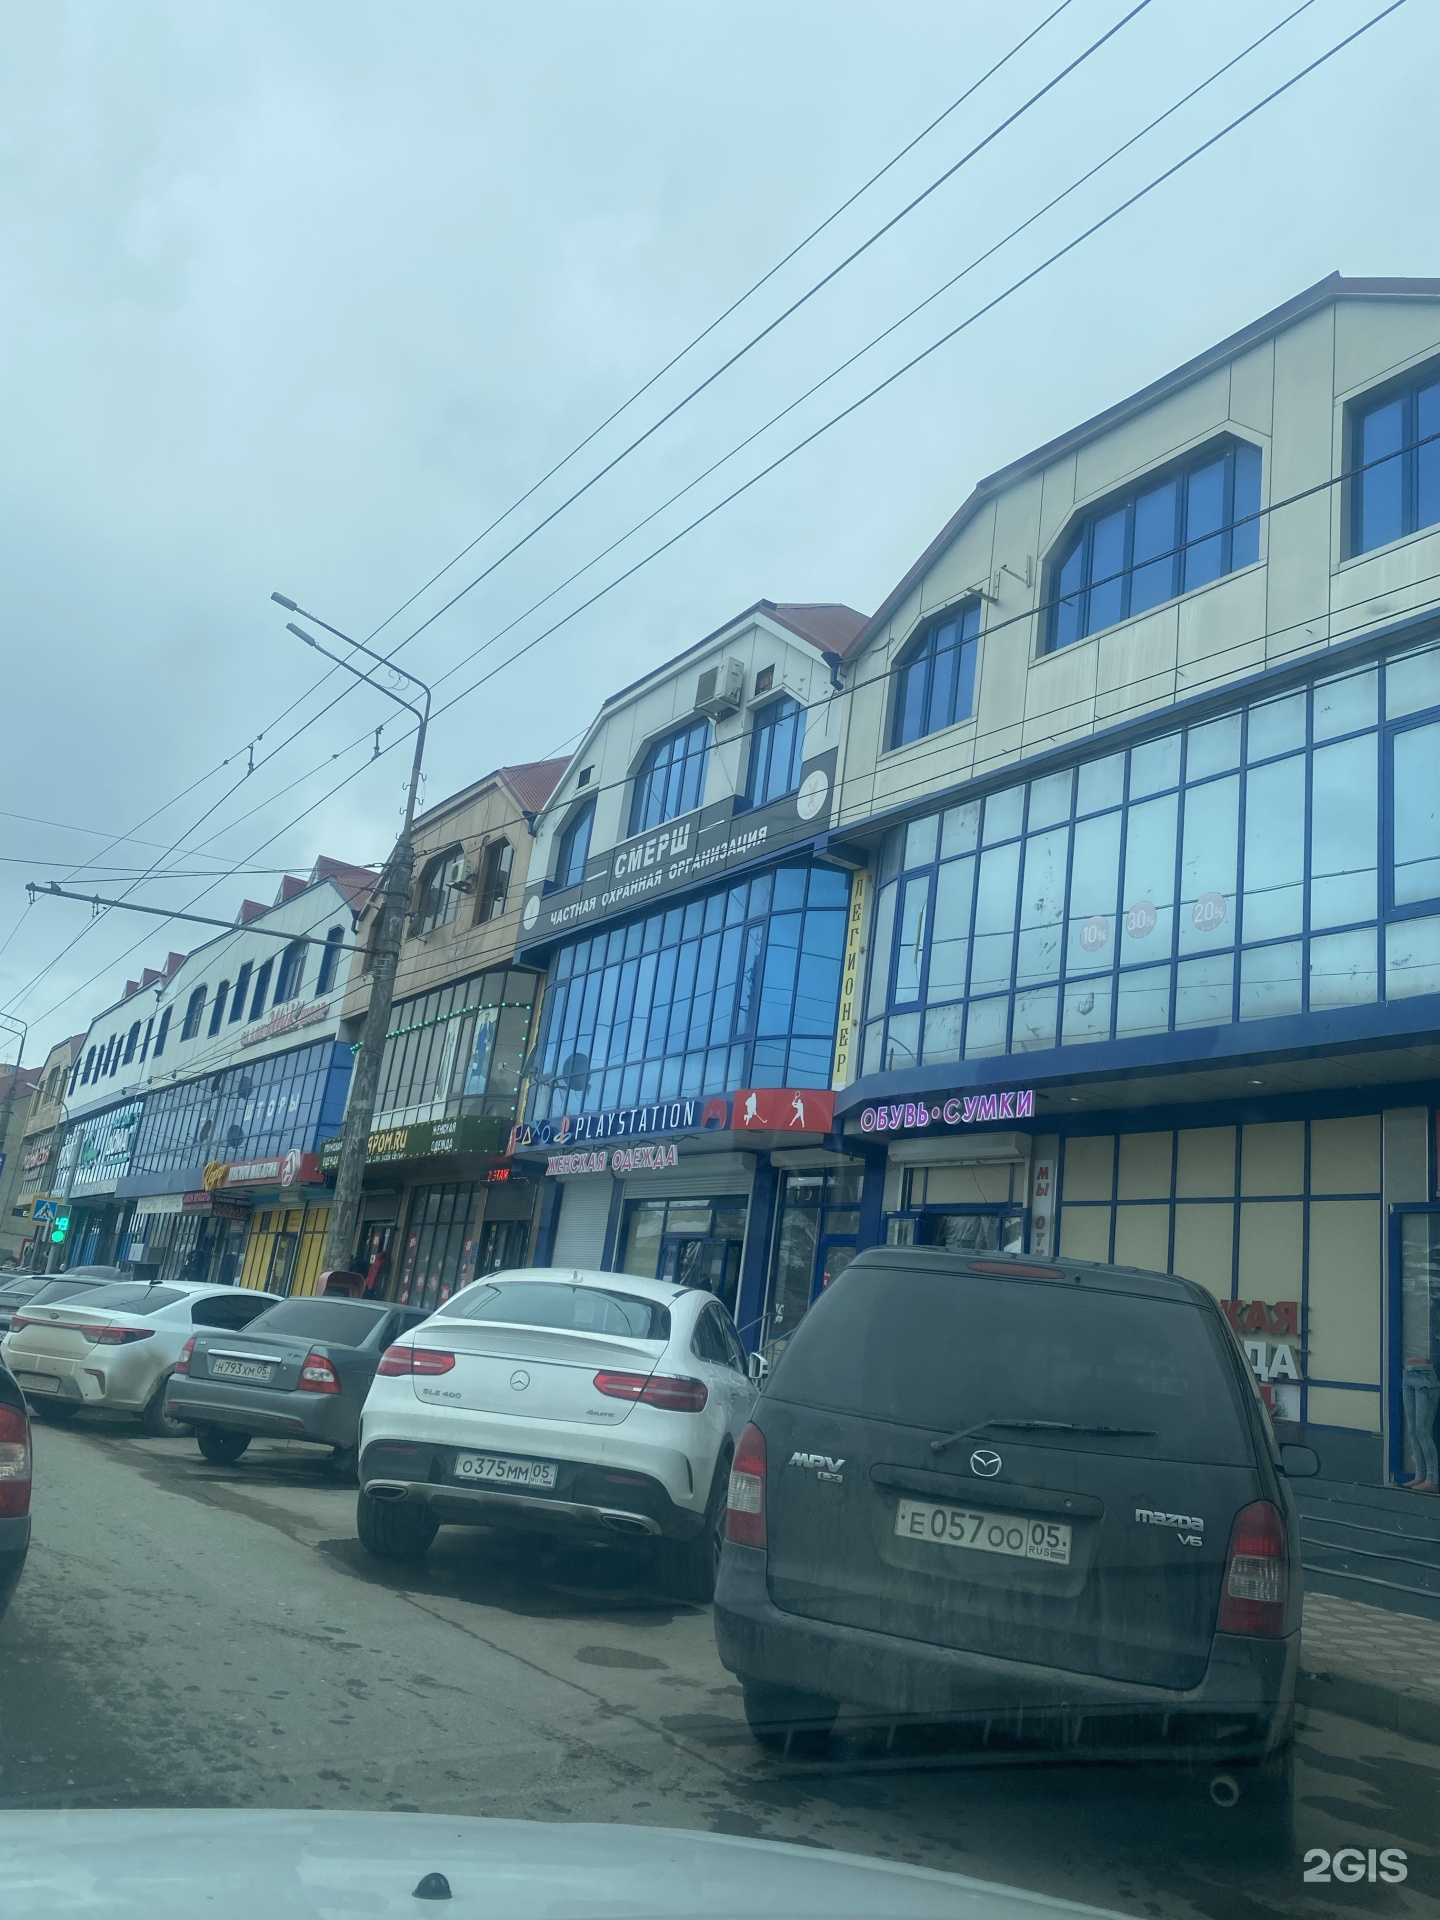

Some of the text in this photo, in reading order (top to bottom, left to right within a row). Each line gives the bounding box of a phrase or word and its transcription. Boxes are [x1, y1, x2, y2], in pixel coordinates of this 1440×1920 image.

[615, 824, 691, 878] СМЕРШ
[550, 826, 768, 926] ЧАСТНАЯ ОХРАННАЯ ОРГАНИЗАЦИЯ
[1127, 910, 1155, 930] 30%
[1194, 902, 1224, 923] 20%
[836, 879, 864, 1073] ЛЕГИОНЕР
[244, 1093, 300, 1120] ШТОРЫ
[861, 1090, 1035, 1132] ОБУВЬ СУМКИ
[575, 1100, 695, 1141] PLAYSTATION
[546, 1144, 678, 1175] ЖЕНСКАЯ ОДЕЖДА
[789, 1452, 845, 1473] MPV
[1135, 1508, 1204, 1532] mazda
[1028, 1545, 1050, 1557] RUS
[1177, 1533, 1203, 1546] V6
